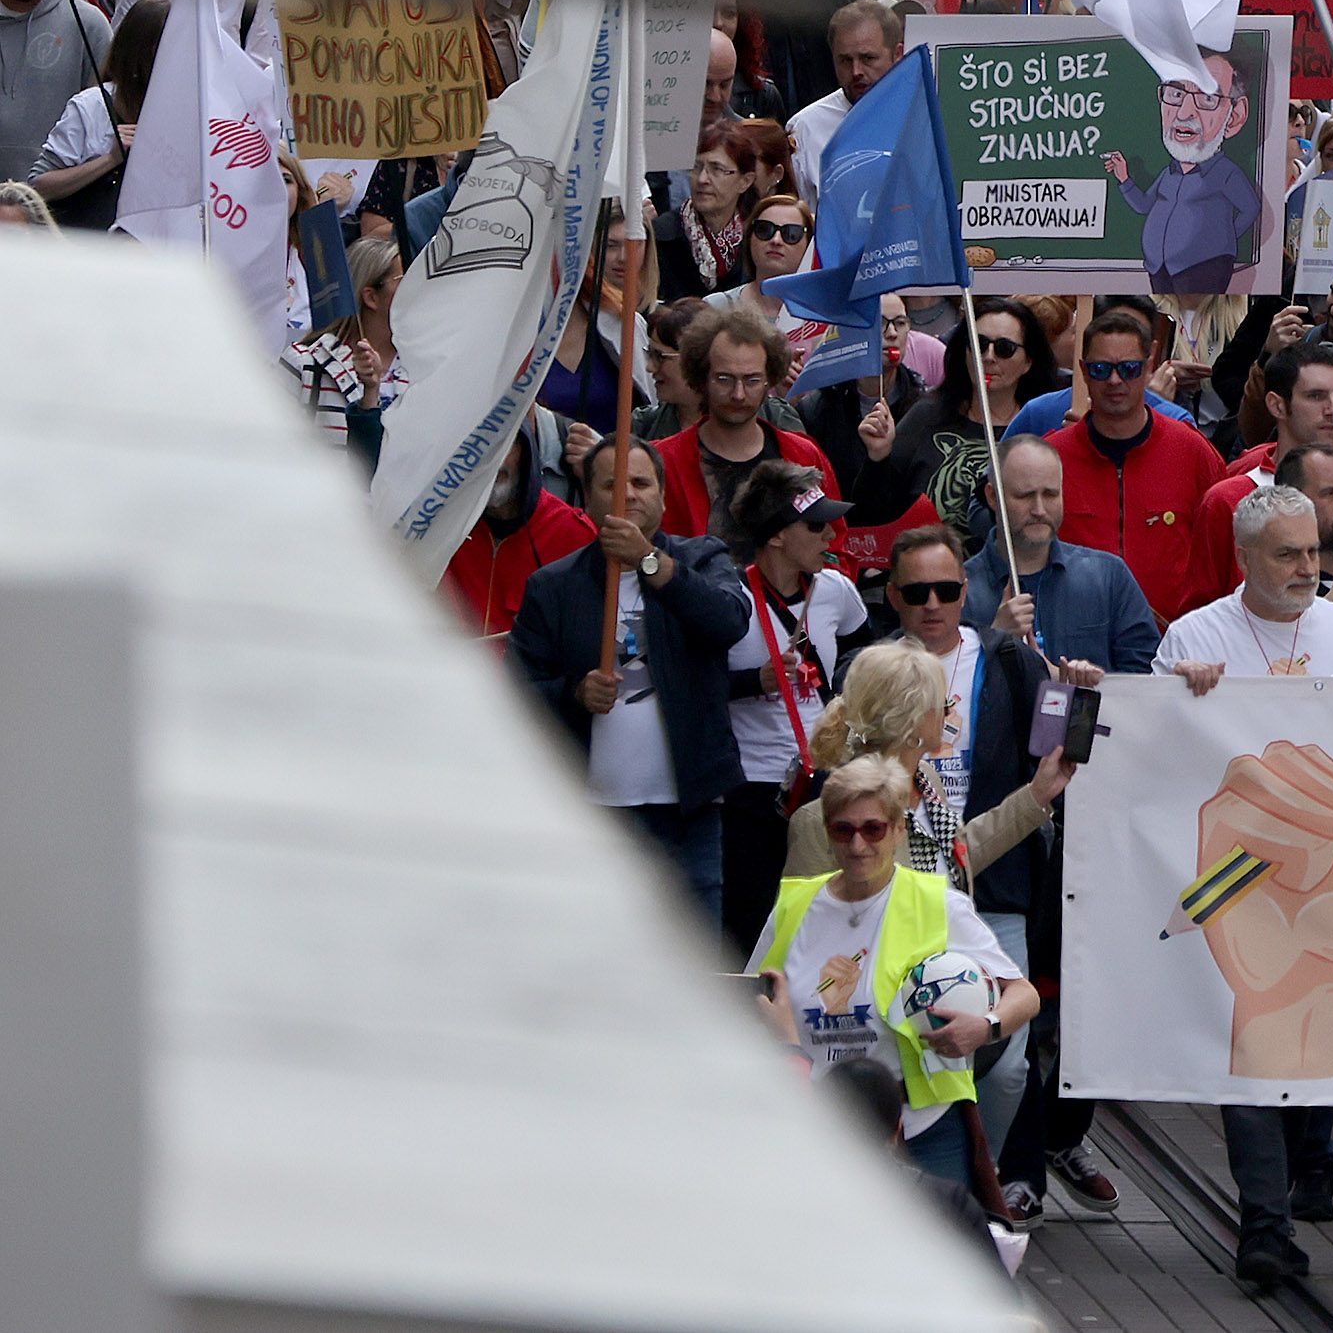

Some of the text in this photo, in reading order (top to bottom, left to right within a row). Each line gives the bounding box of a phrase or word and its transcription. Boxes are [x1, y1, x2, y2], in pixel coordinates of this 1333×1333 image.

[959, 51, 1110, 92] ŠTO BEZ
[292, 91, 367, 148] HITNO
[968, 86, 1106, 130] STRUČNOG
[979, 125, 1101, 164] ZNANJA?
[985, 182, 1068, 204] MINISTAR
[449, 216, 526, 251] SLOBODA
[967, 204, 1098, 230] OBRAZOVANJA!
